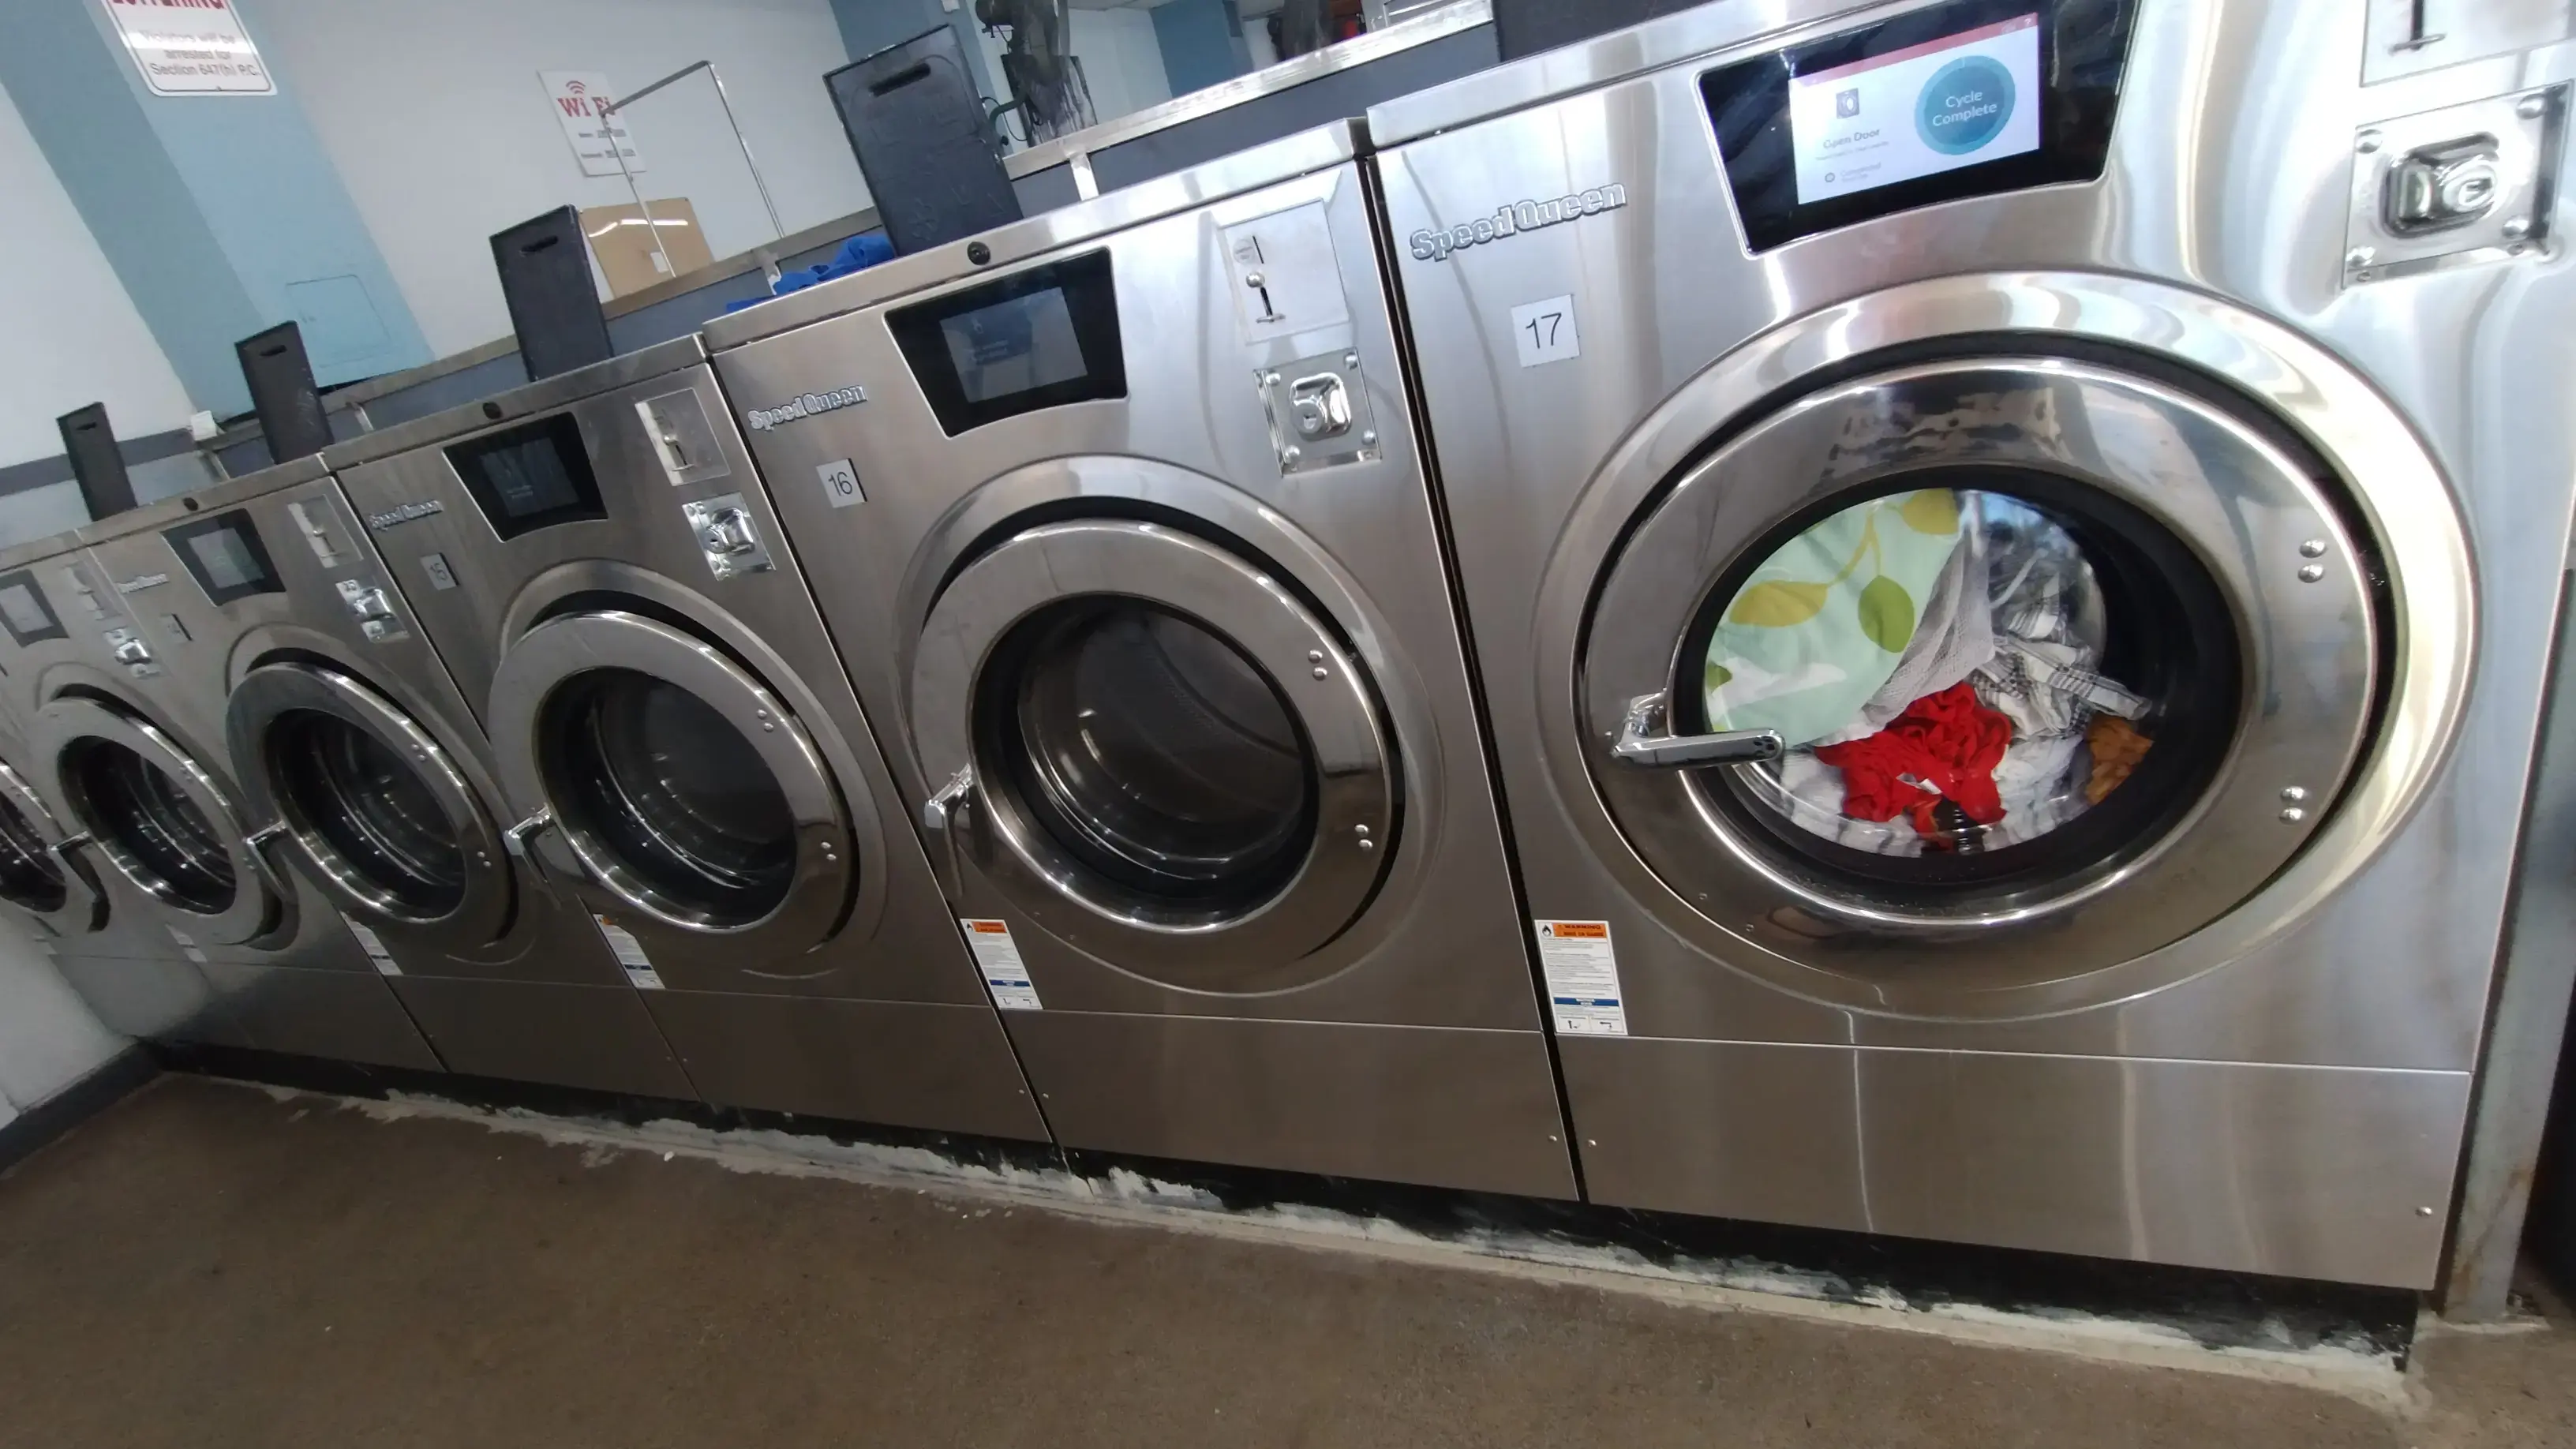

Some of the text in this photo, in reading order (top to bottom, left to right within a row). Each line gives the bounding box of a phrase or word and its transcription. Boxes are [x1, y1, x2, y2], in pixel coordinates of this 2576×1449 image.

[149, 62, 197, 76] Section
[1945, 90, 1983, 107] Cycle
[1932, 103, 1998, 126] Complete
[1823, 129, 1880, 149] Open Door
[1526, 312, 1562, 350] 17
[828, 471, 853, 497] 16
